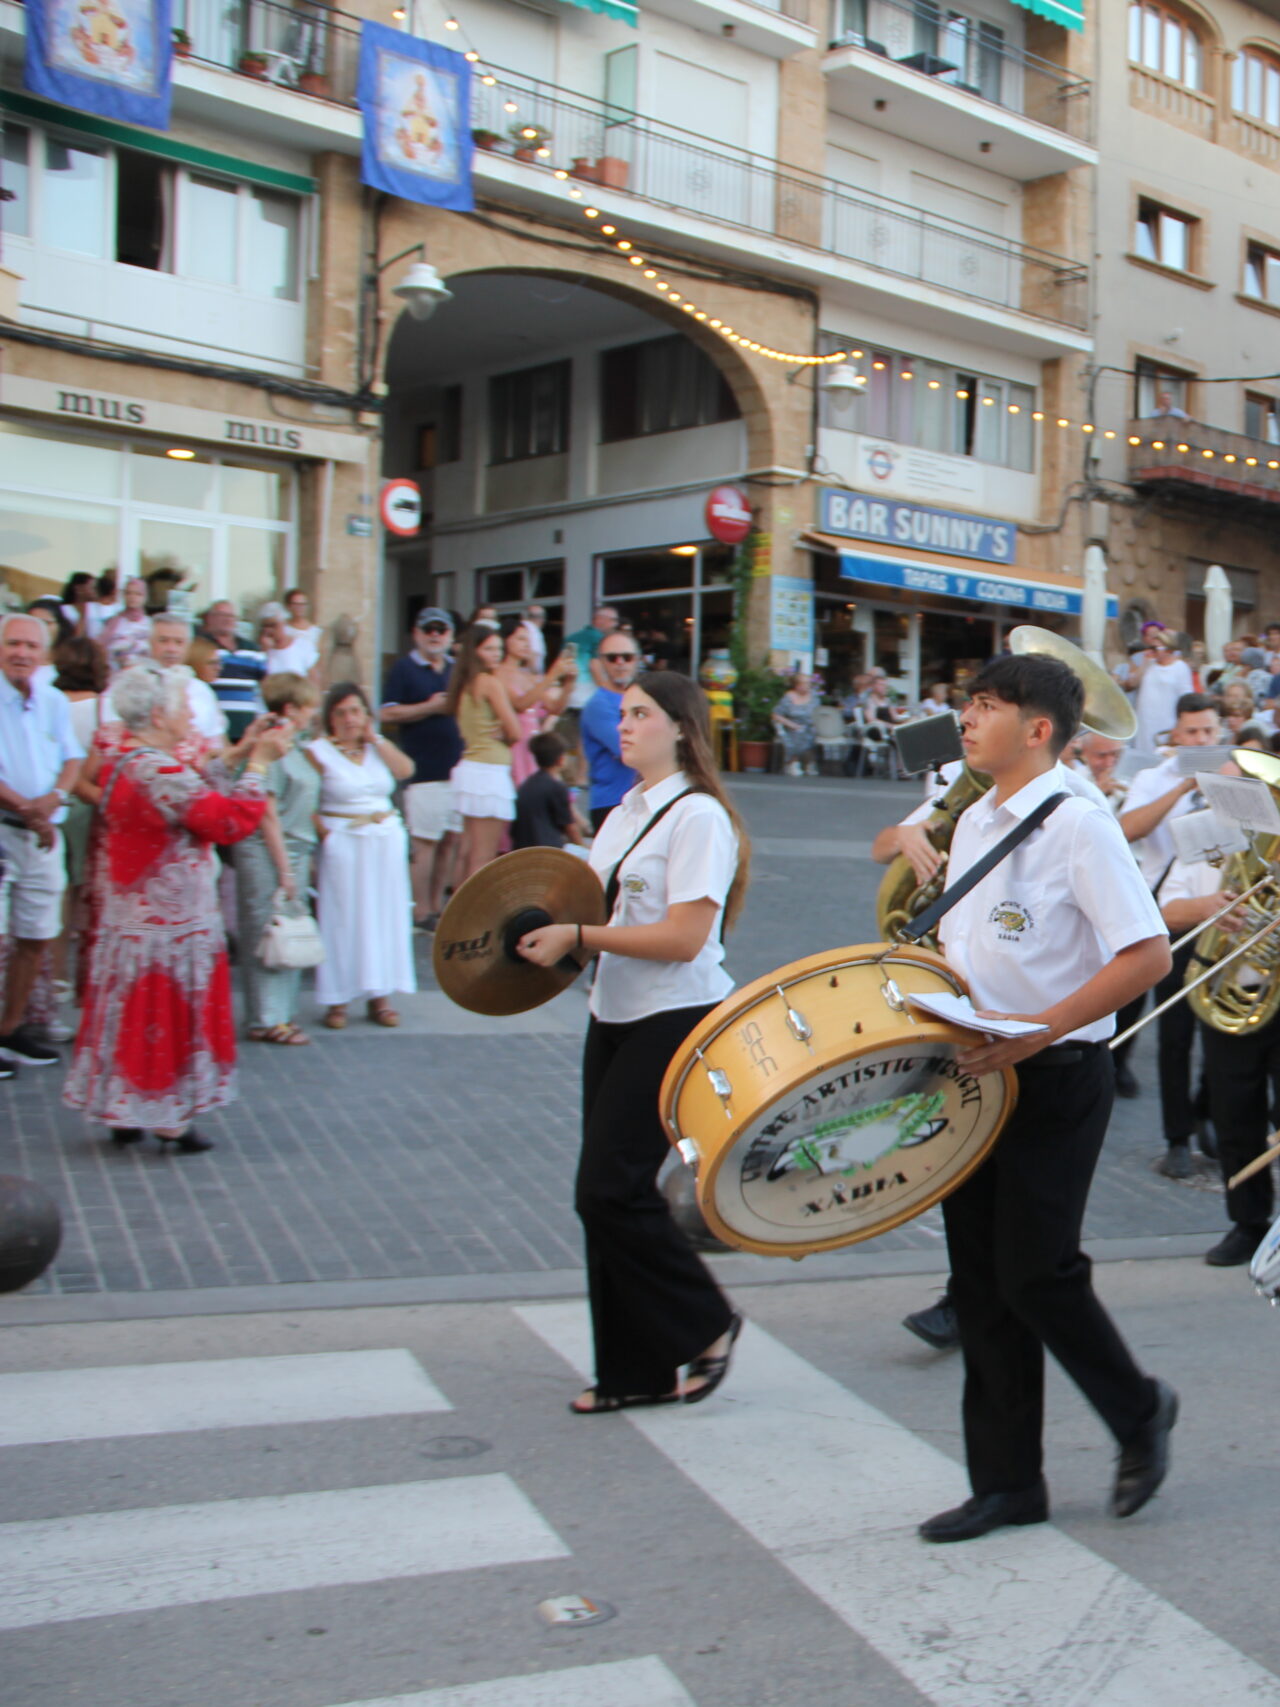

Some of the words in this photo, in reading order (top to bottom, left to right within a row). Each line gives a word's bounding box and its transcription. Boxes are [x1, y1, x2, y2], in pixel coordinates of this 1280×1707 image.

[57, 390, 145, 424] mus
[225, 419, 302, 450] mus
[829, 495, 889, 536] BAR
[895, 507, 1009, 558] SUNNY'S
[903, 567, 948, 592] TAPAS
[956, 577, 968, 595] Y
